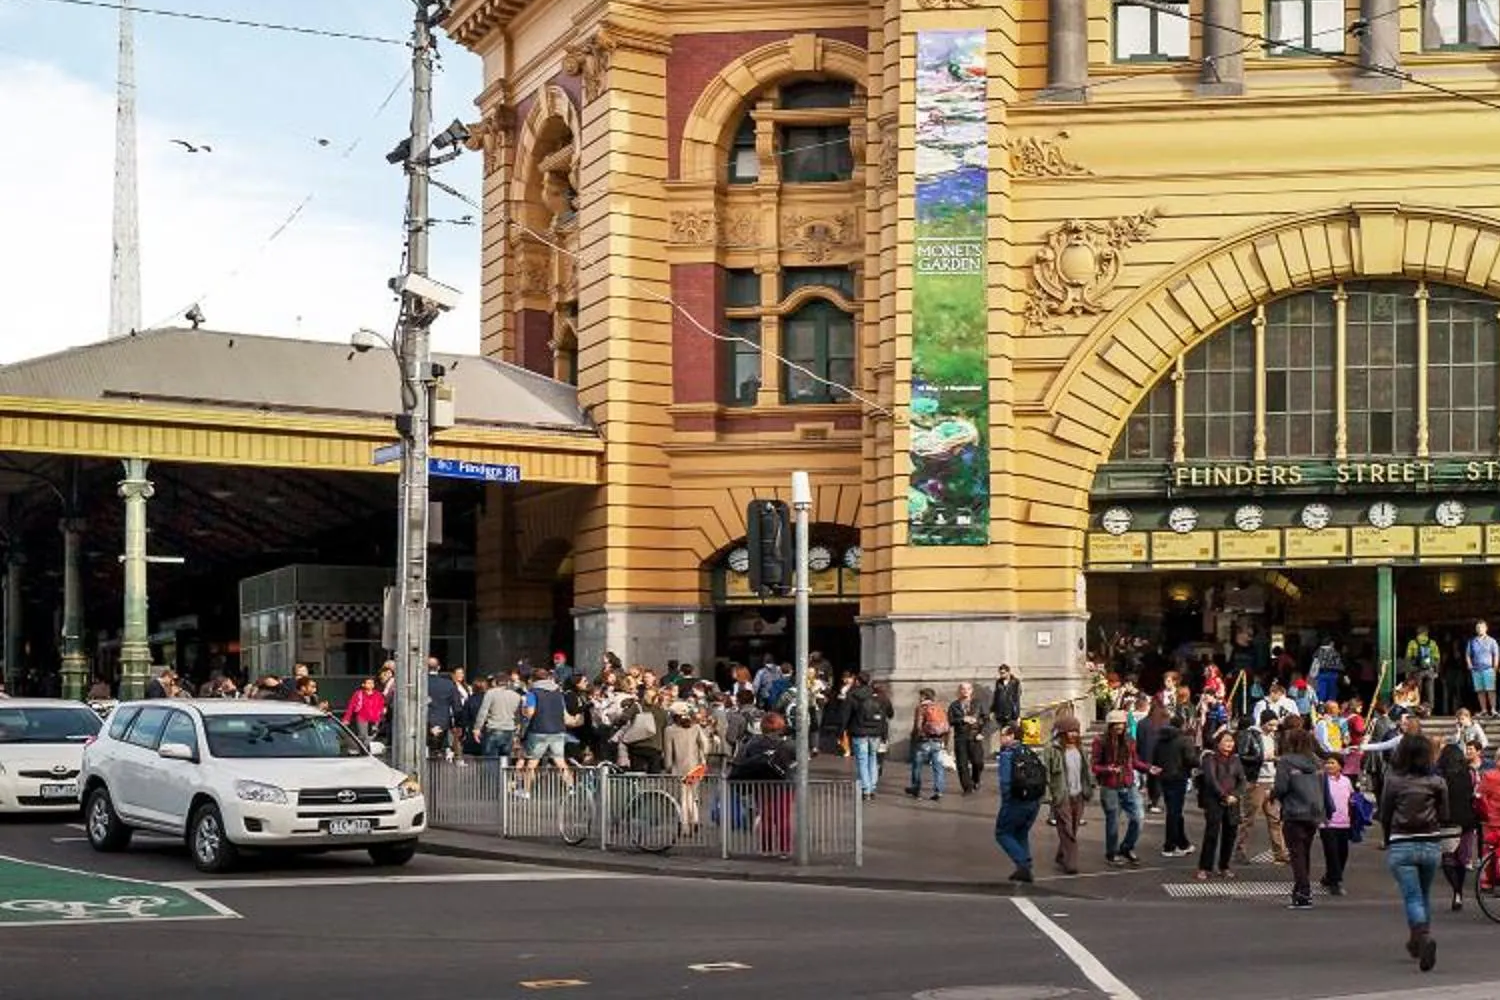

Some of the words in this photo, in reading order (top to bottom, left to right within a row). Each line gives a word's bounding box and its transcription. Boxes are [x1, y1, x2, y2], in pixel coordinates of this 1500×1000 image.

[917, 244, 982, 257] MONET'S
[918, 257, 981, 271] GARDEN
[1176, 465, 1301, 486] FLINDERS
[1336, 463, 1434, 483] STREET
